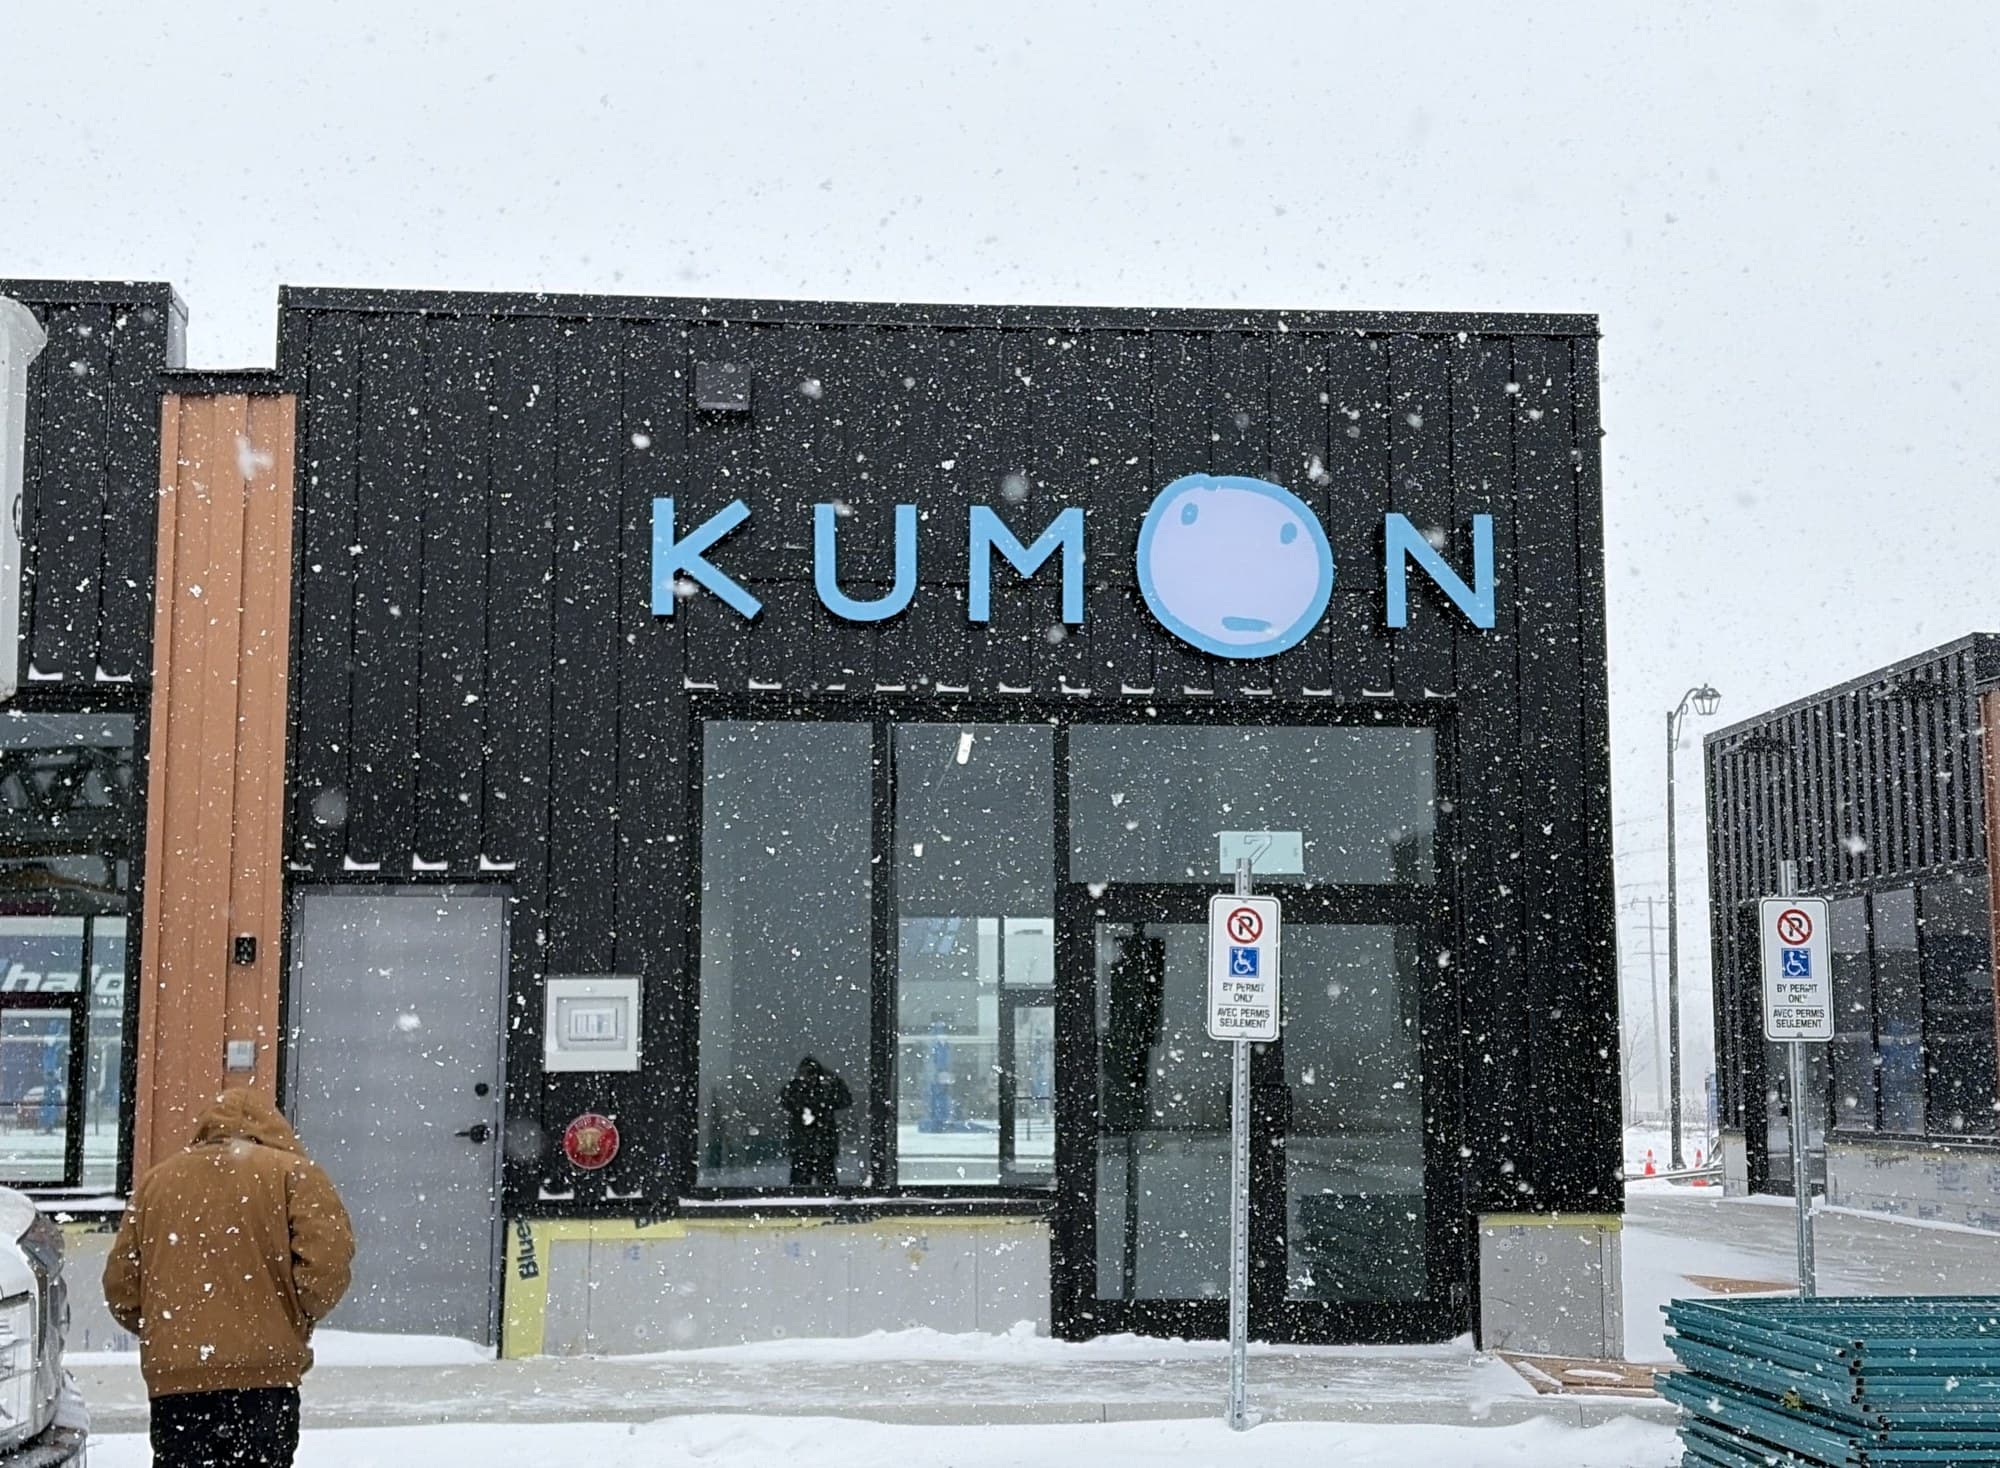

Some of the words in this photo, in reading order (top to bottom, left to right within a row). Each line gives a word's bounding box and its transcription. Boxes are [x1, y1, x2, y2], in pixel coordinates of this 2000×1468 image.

[651, 473, 1496, 659] KUMON
[1222, 982, 1233, 992] BY
[1236, 982, 1265, 993] PERMIT
[1776, 983, 1788, 993] BY
[1789, 983, 1818, 993] PERMIT
[1233, 992, 1254, 1003] ONLY
[1788, 993, 1808, 1004] ONLY
[1217, 1007, 1238, 1018] AVEC
[1240, 1008, 1271, 1020] PERMIS
[1773, 1008, 1794, 1019] AVEC
[1795, 1008, 1826, 1019] PERMIS
[1219, 1017, 1267, 1029] SEULEMENT
[1775, 1018, 1824, 1029] SEULEMENT
